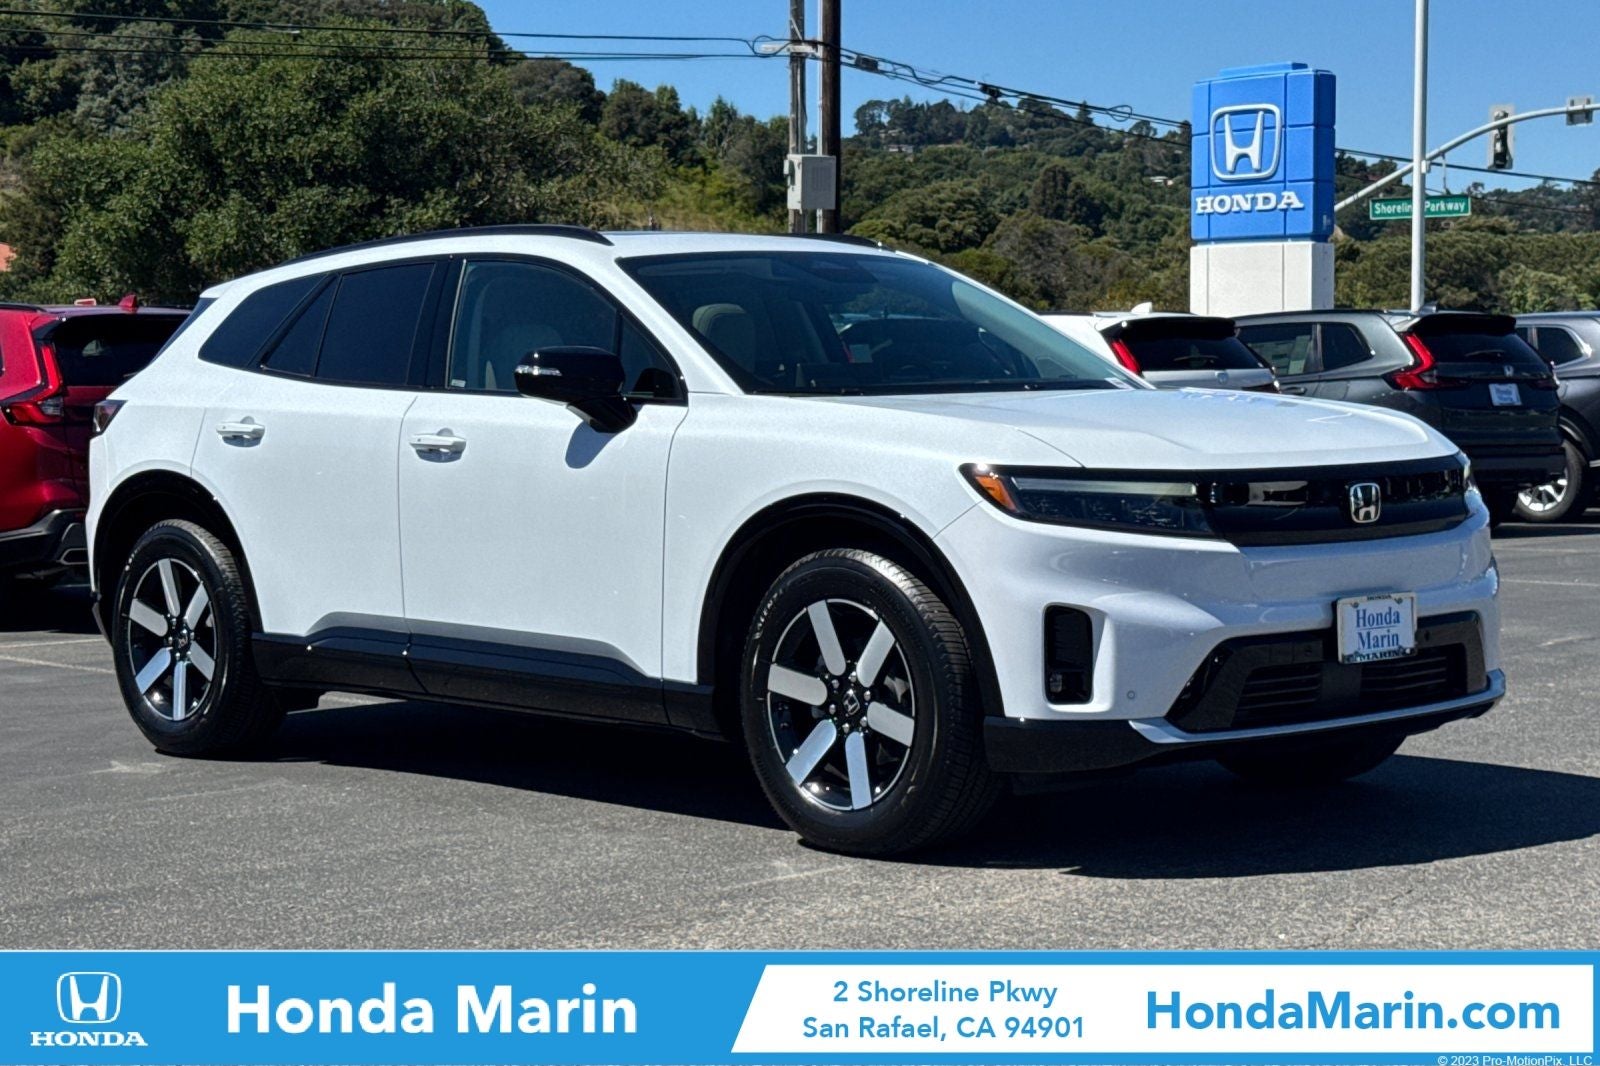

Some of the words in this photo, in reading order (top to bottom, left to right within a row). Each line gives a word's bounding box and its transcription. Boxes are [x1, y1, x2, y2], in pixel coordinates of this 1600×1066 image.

[1195, 190, 1305, 214] HONDA
[1374, 202, 1413, 215] Shorelin
[1424, 200, 1465, 212] Parkway
[1356, 606, 1401, 628] Honda
[1358, 629, 1399, 650] Marin
